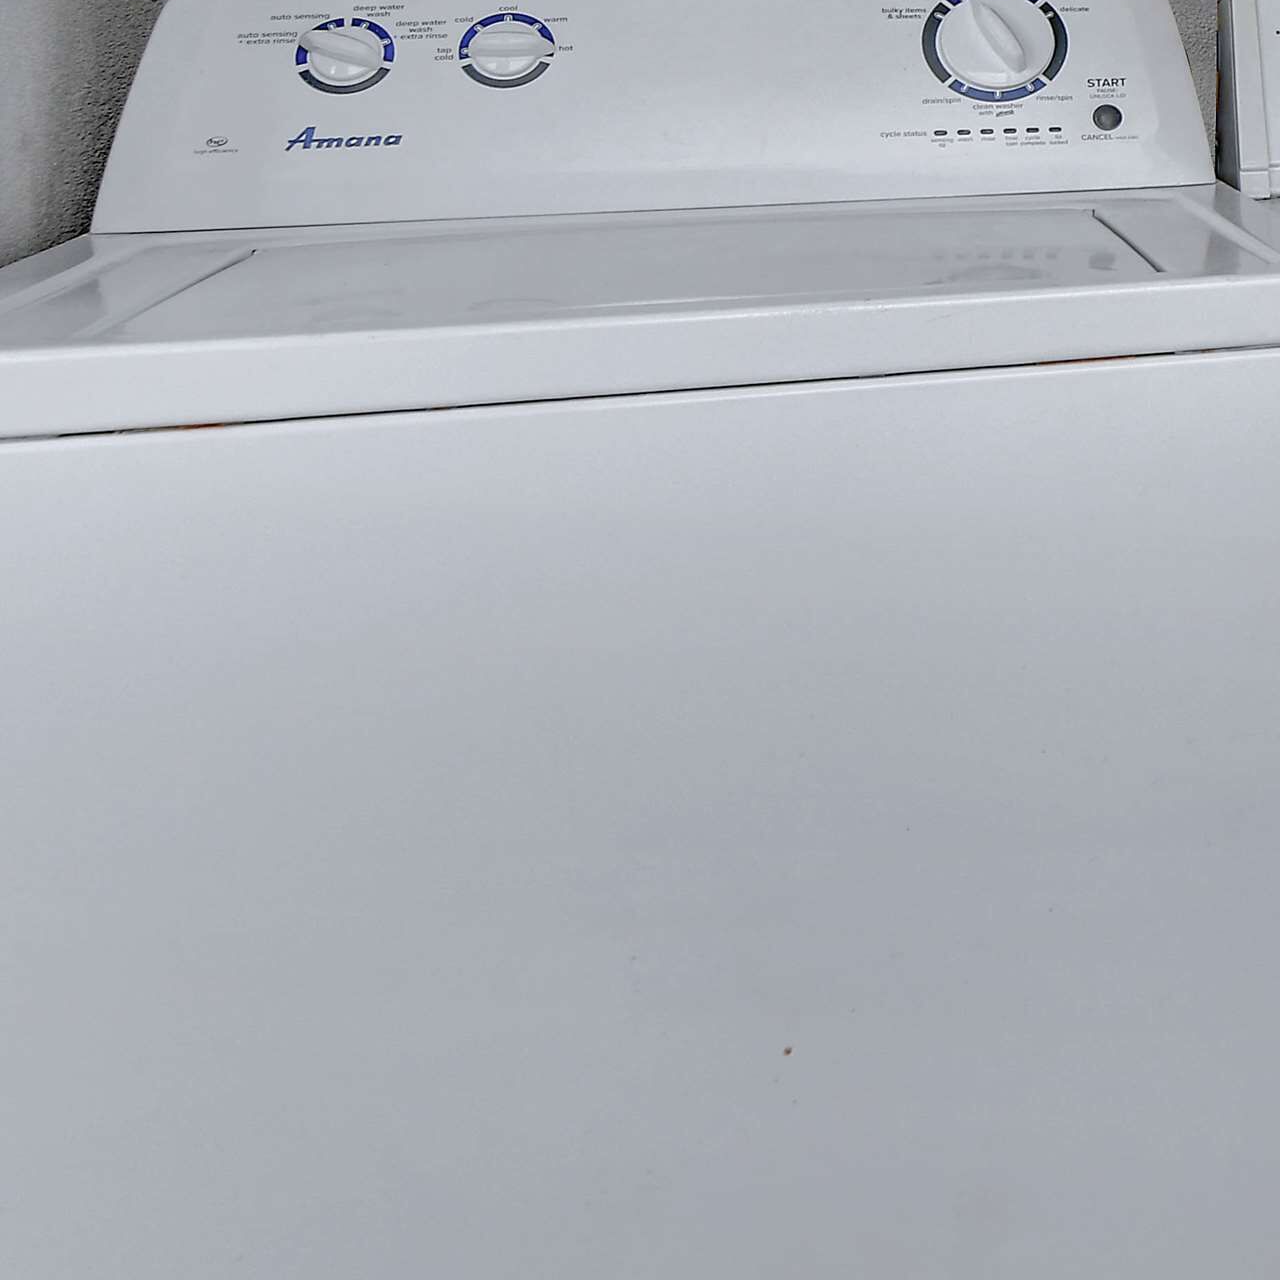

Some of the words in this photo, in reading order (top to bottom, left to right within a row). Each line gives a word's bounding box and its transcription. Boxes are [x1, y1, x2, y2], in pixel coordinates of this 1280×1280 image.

[353, 4, 377, 12] deep
[379, 3, 405, 11] water
[437, 47, 452, 55] tap
[1087, 77, 1127, 88] START
[284, 126, 402, 152] Amana
